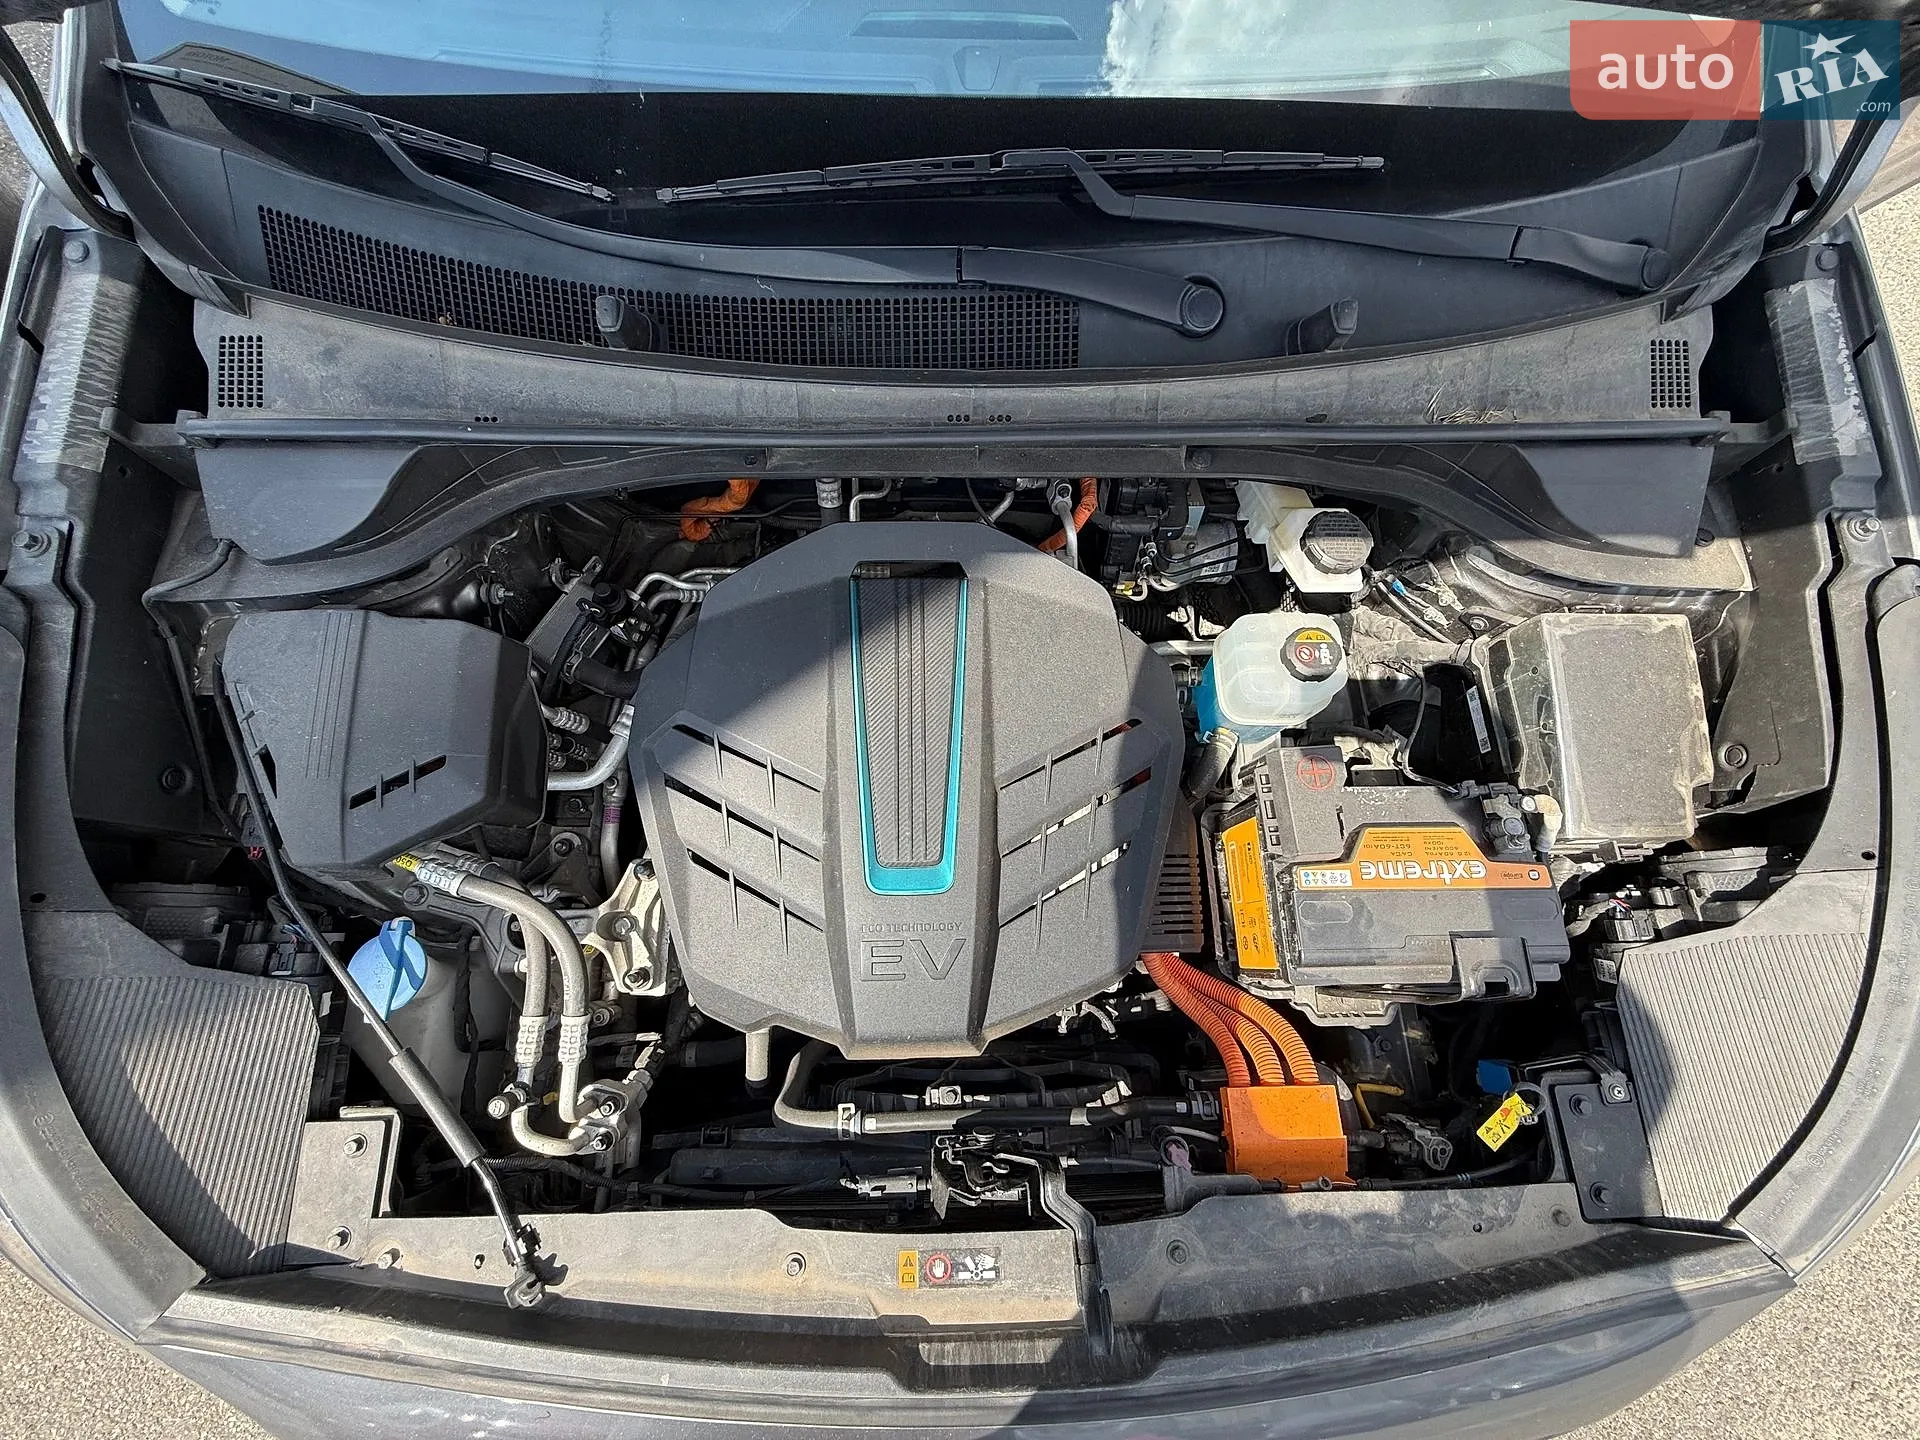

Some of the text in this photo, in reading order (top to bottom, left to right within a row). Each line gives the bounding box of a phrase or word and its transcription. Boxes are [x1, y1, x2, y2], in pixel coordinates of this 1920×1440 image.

[1359, 860, 1487, 885] extreme
[888, 922, 963, 933] TECHNOLOGY
[860, 938, 967, 981] EV
